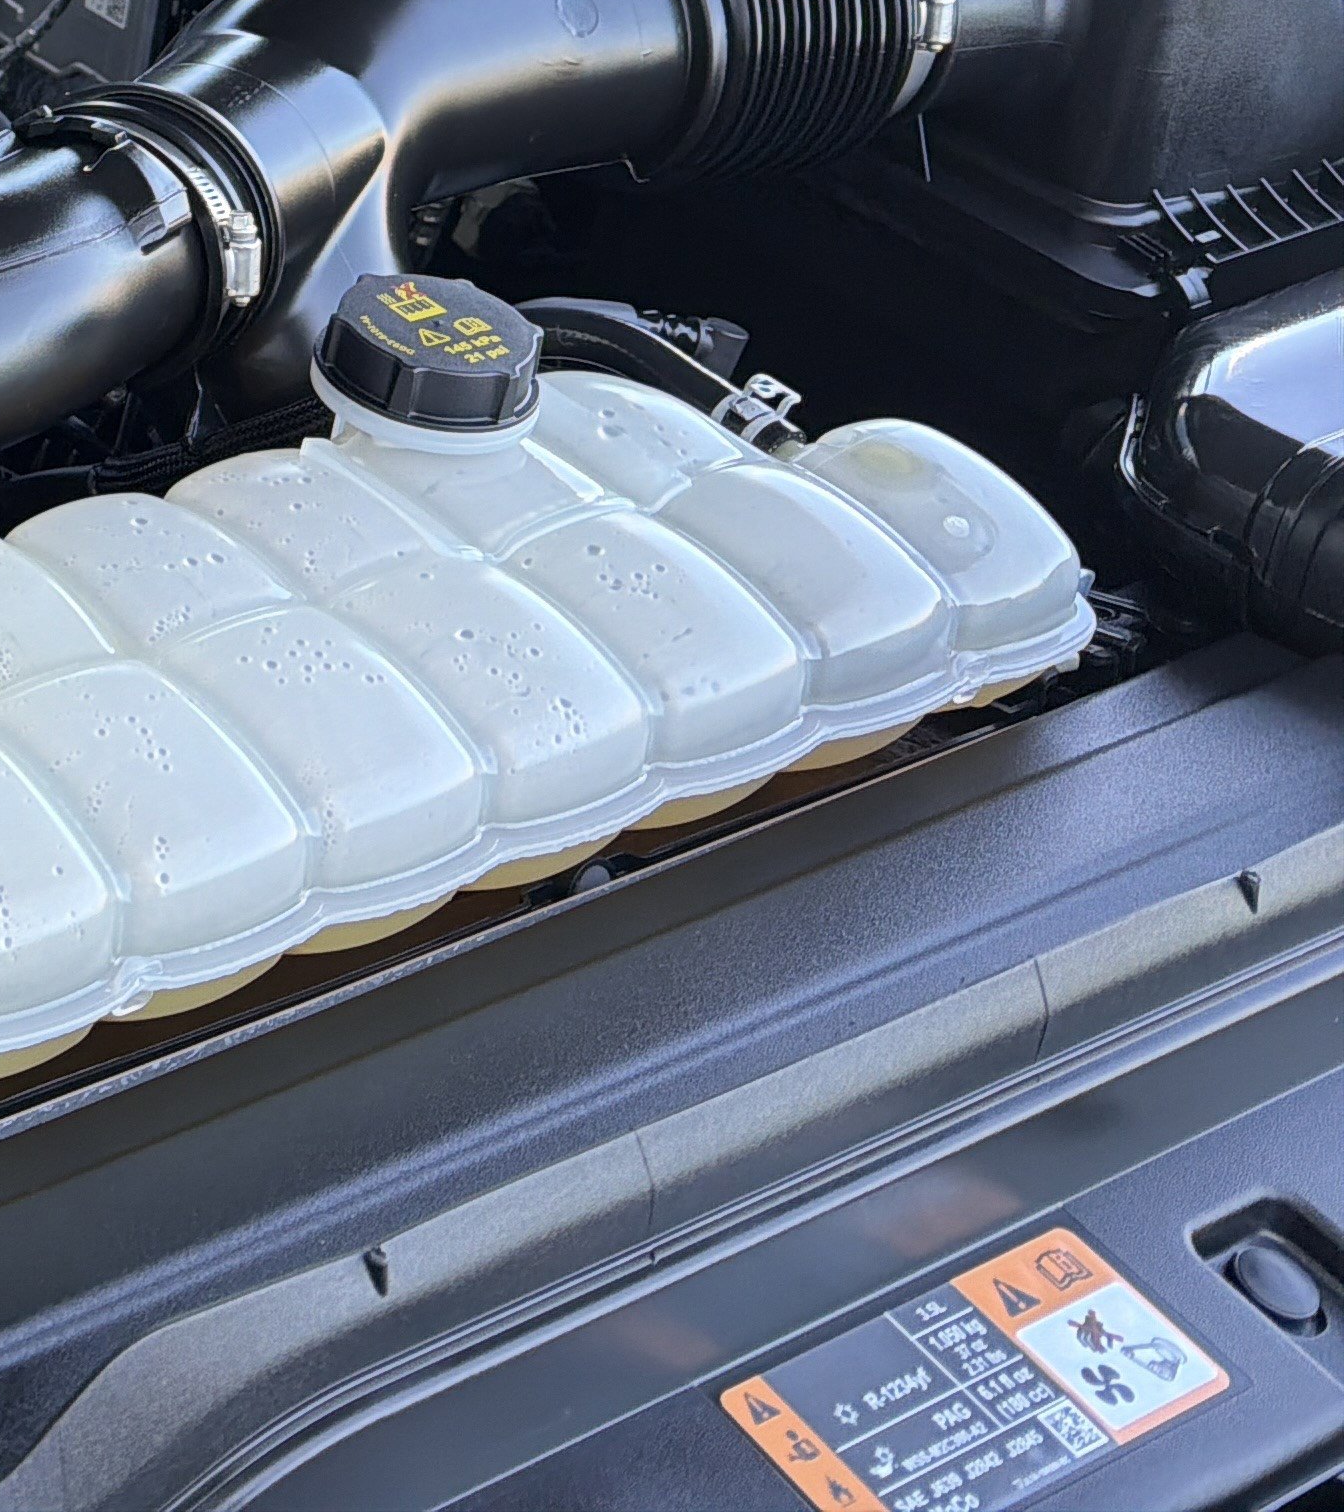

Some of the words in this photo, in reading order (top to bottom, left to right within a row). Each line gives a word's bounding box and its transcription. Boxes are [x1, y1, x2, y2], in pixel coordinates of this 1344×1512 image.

[444, 340, 473, 355] 145
[470, 335, 502, 348] kPa
[464, 352, 485, 364] 21
[486, 345, 511, 359] psi
[863, 1366, 932, 1411] R-1234yf
[977, 1381, 1000, 1402] 6.1
[1012, 1364, 1035, 1384] oz
[1025, 1383, 1056, 1403] cc)
[931, 1402, 972, 1430] PAG
[895, 1489, 929, 1511] SAE
